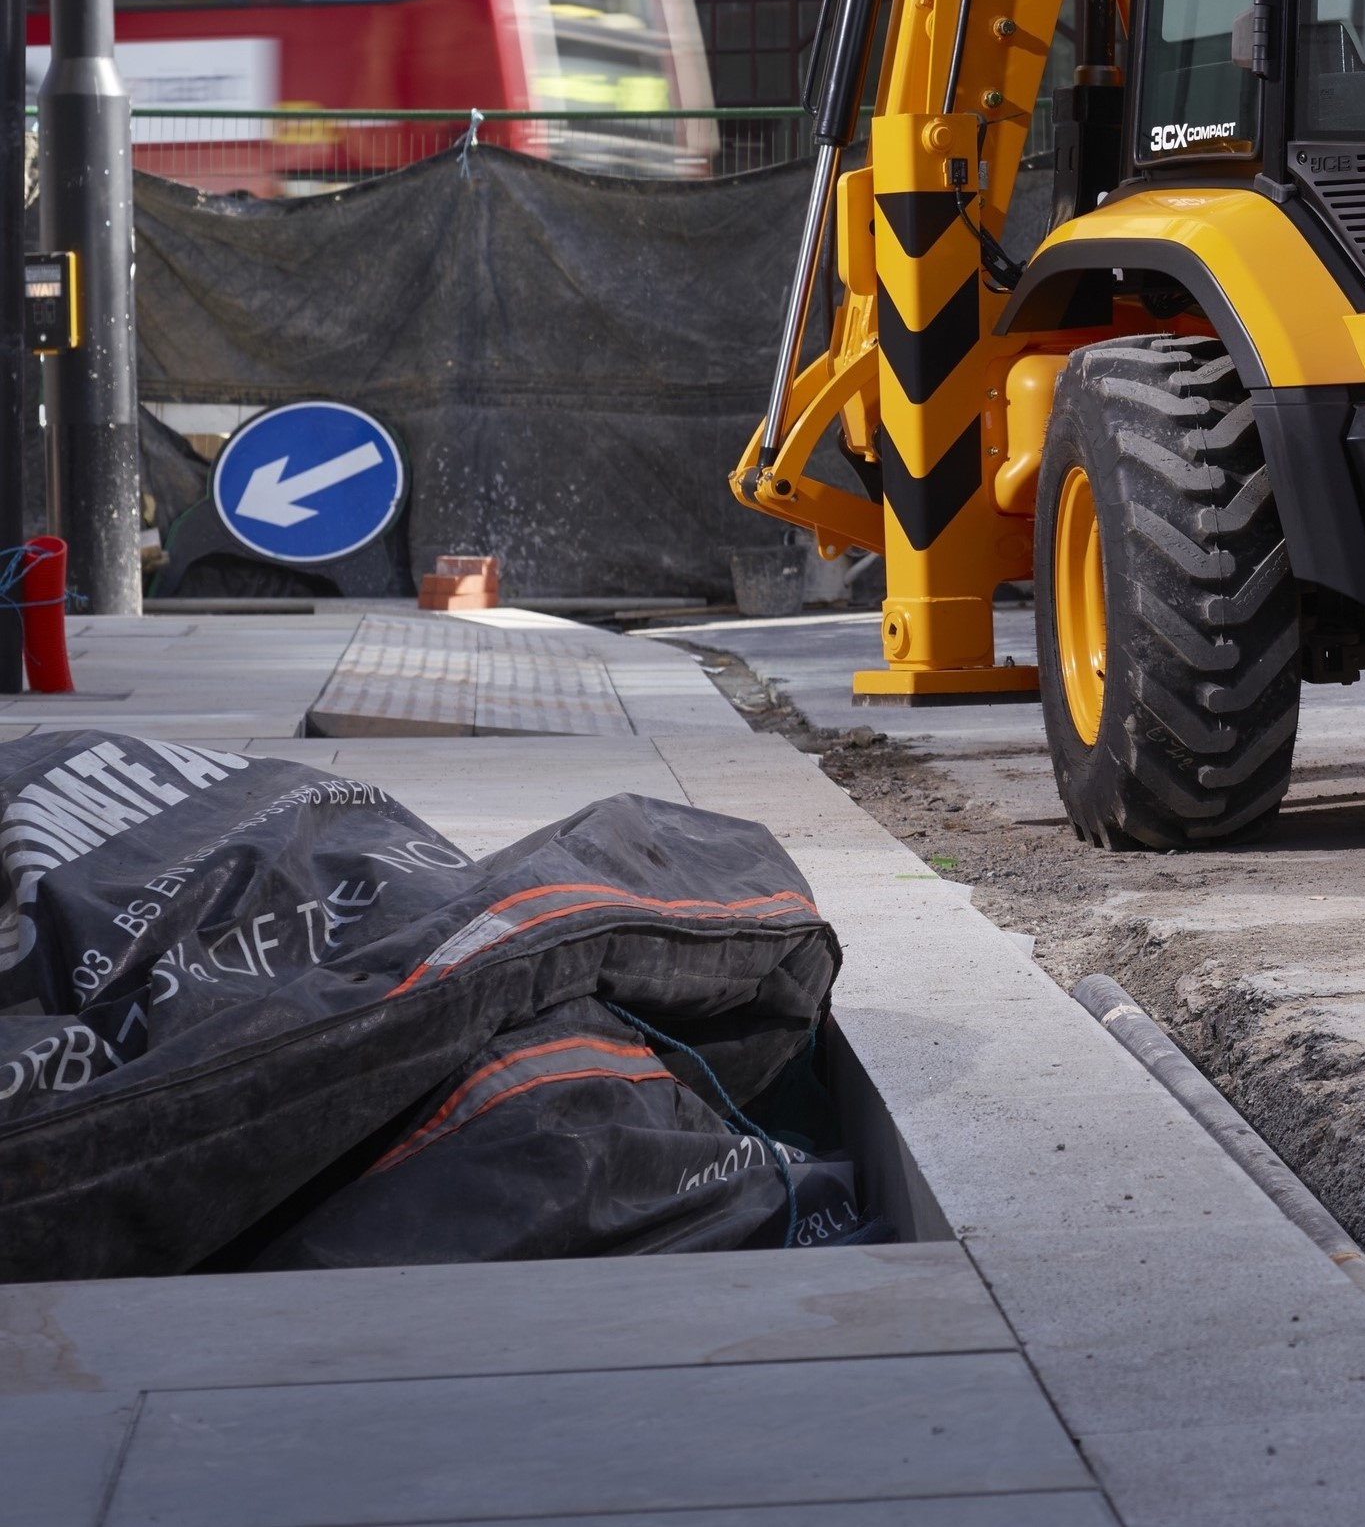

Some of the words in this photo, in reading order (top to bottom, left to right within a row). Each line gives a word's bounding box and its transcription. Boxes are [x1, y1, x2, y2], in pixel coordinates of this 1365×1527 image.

[1150, 123, 1189, 152] 3CX
[1186, 121, 1237, 142] COMPACT
[1310, 155, 1354, 174] JCB
[31, 284, 59, 297] WAIT
[112, 899, 162, 939] BS
[144, 867, 196, 899] EN
[318, 780, 350, 805] BS
[208, 912, 279, 978] OF
